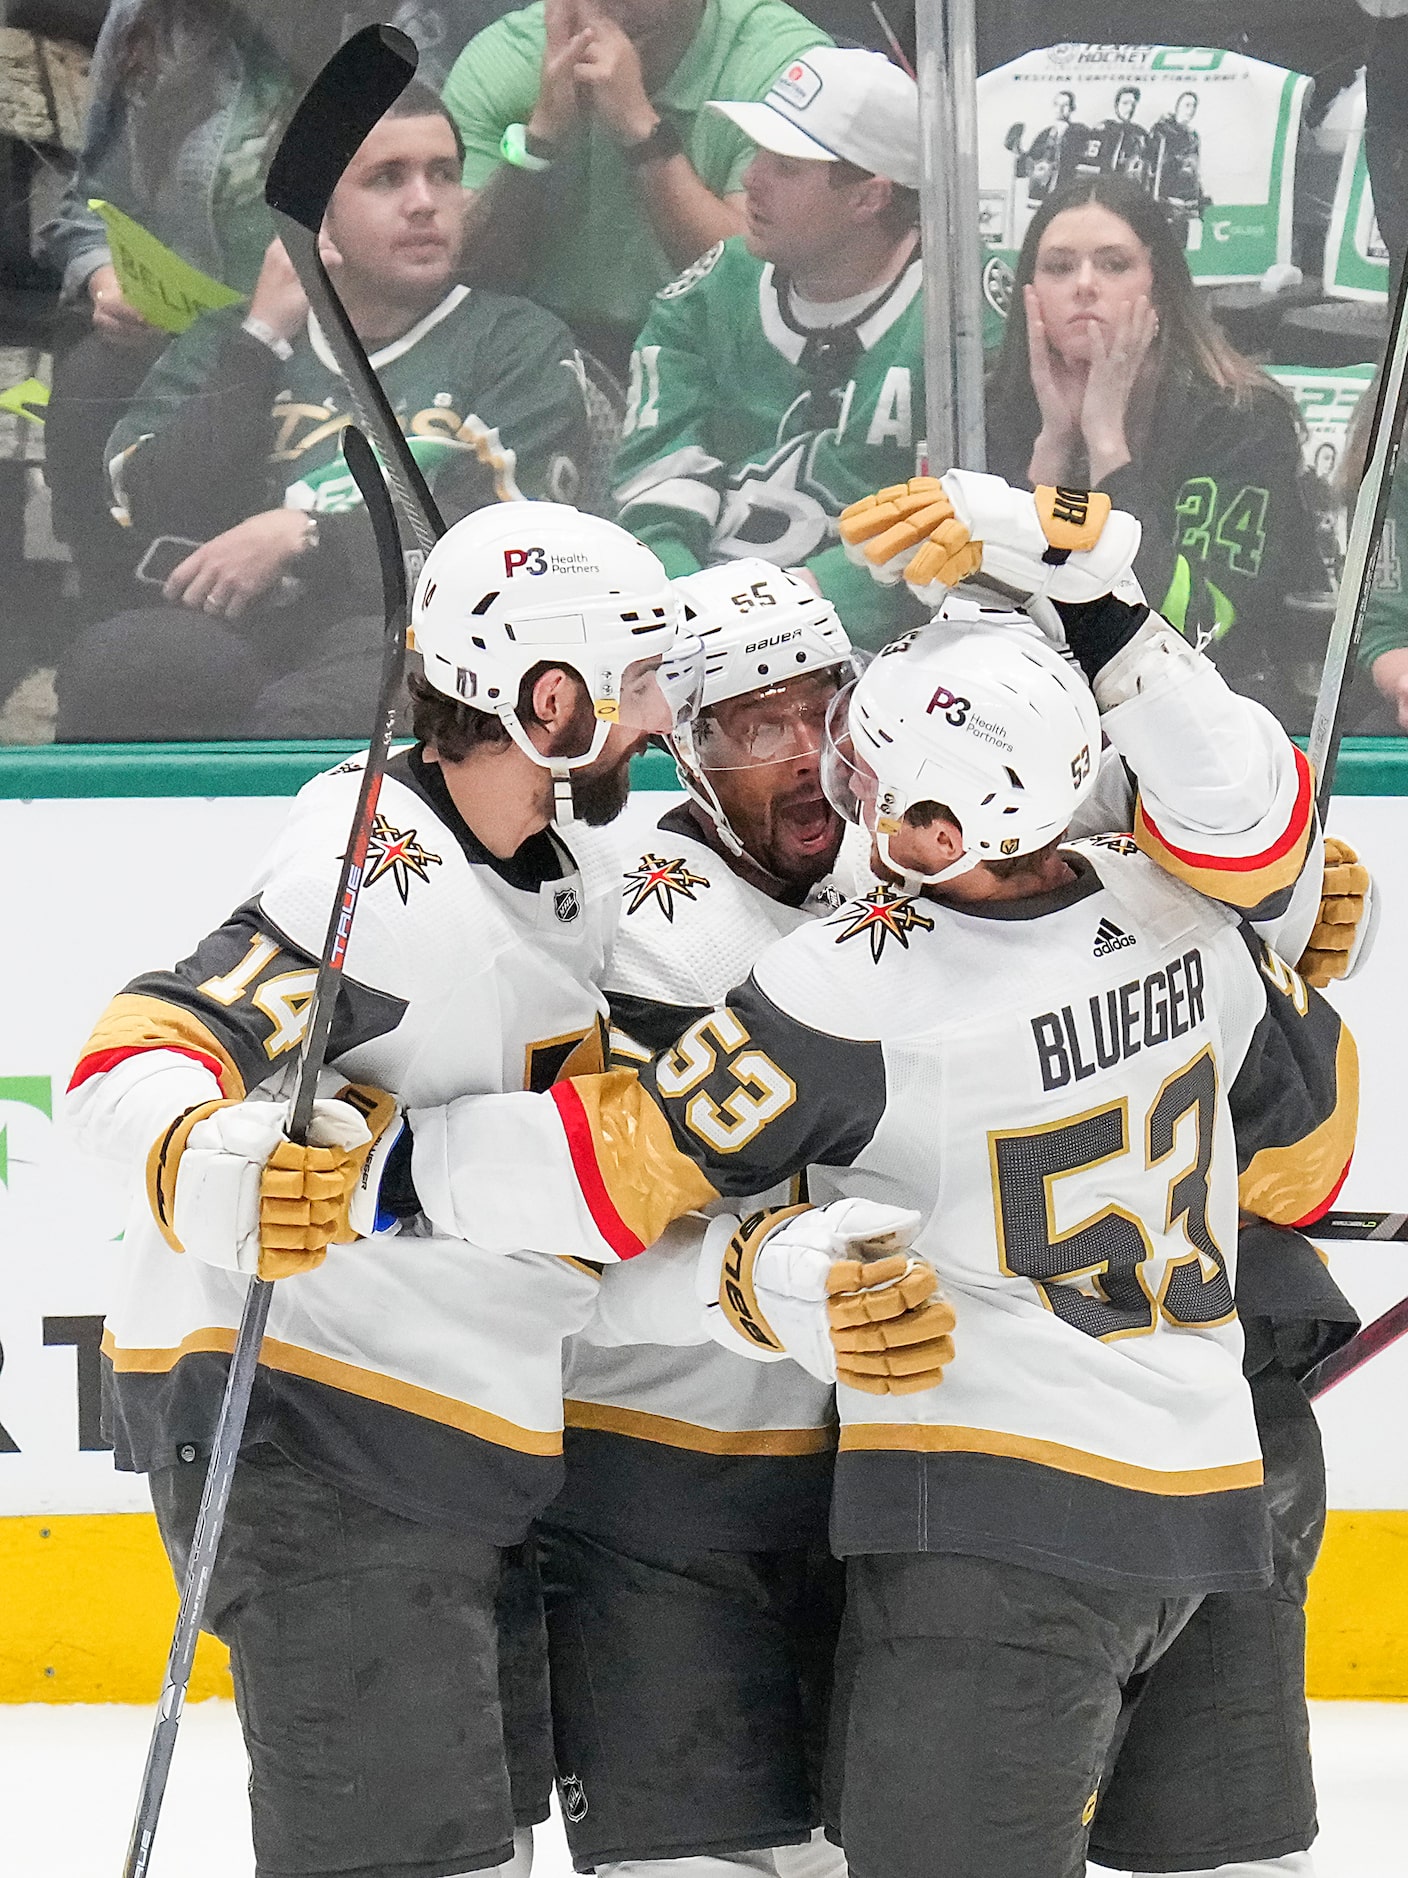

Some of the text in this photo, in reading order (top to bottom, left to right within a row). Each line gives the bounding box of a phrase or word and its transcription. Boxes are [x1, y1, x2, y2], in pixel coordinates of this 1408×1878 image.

[866, 366, 912, 447] A
[1174, 476, 1270, 578] 24
[503, 547, 549, 578] P3
[551, 553, 589, 564] Health
[552, 563, 601, 575] Partners
[731, 581, 777, 614] 55
[745, 628, 804, 655] BAUER
[925, 686, 972, 728] P3
[969, 712, 1008, 738] Health
[965, 723, 1014, 753] Partners
[1070, 744, 1091, 790] 53
[331, 864, 362, 963] TRUE
[1093, 932, 1137, 958] adidas
[196, 931, 320, 1061] 14
[1031, 948, 1206, 1092] BLUEGER
[656, 1006, 797, 1154] 53
[986, 1041, 1238, 1344] 53
[0, 1314, 115, 1453] T
